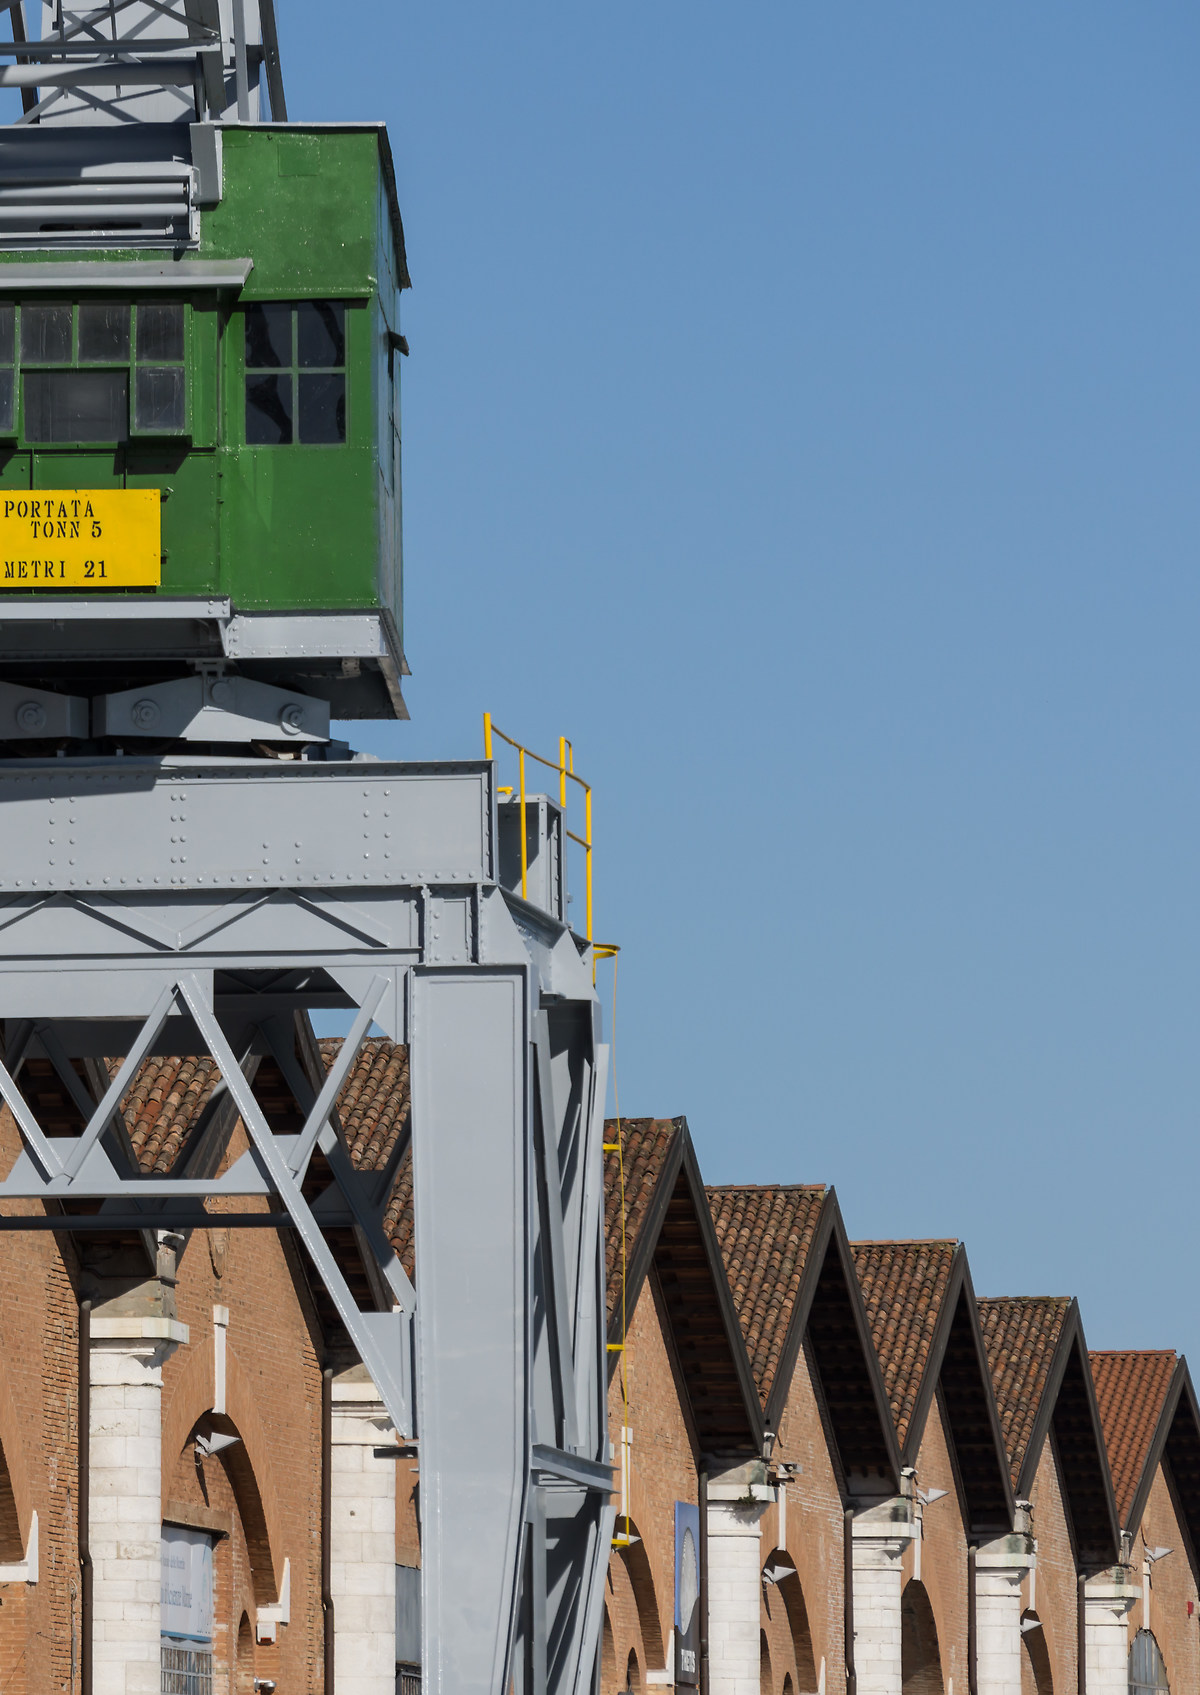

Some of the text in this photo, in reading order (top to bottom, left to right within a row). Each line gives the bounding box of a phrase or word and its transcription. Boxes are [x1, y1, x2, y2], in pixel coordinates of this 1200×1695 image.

[5, 500, 94, 517] PORTATA
[31, 521, 101, 538] TONN 5
[5, 561, 107, 578] METRI 21
